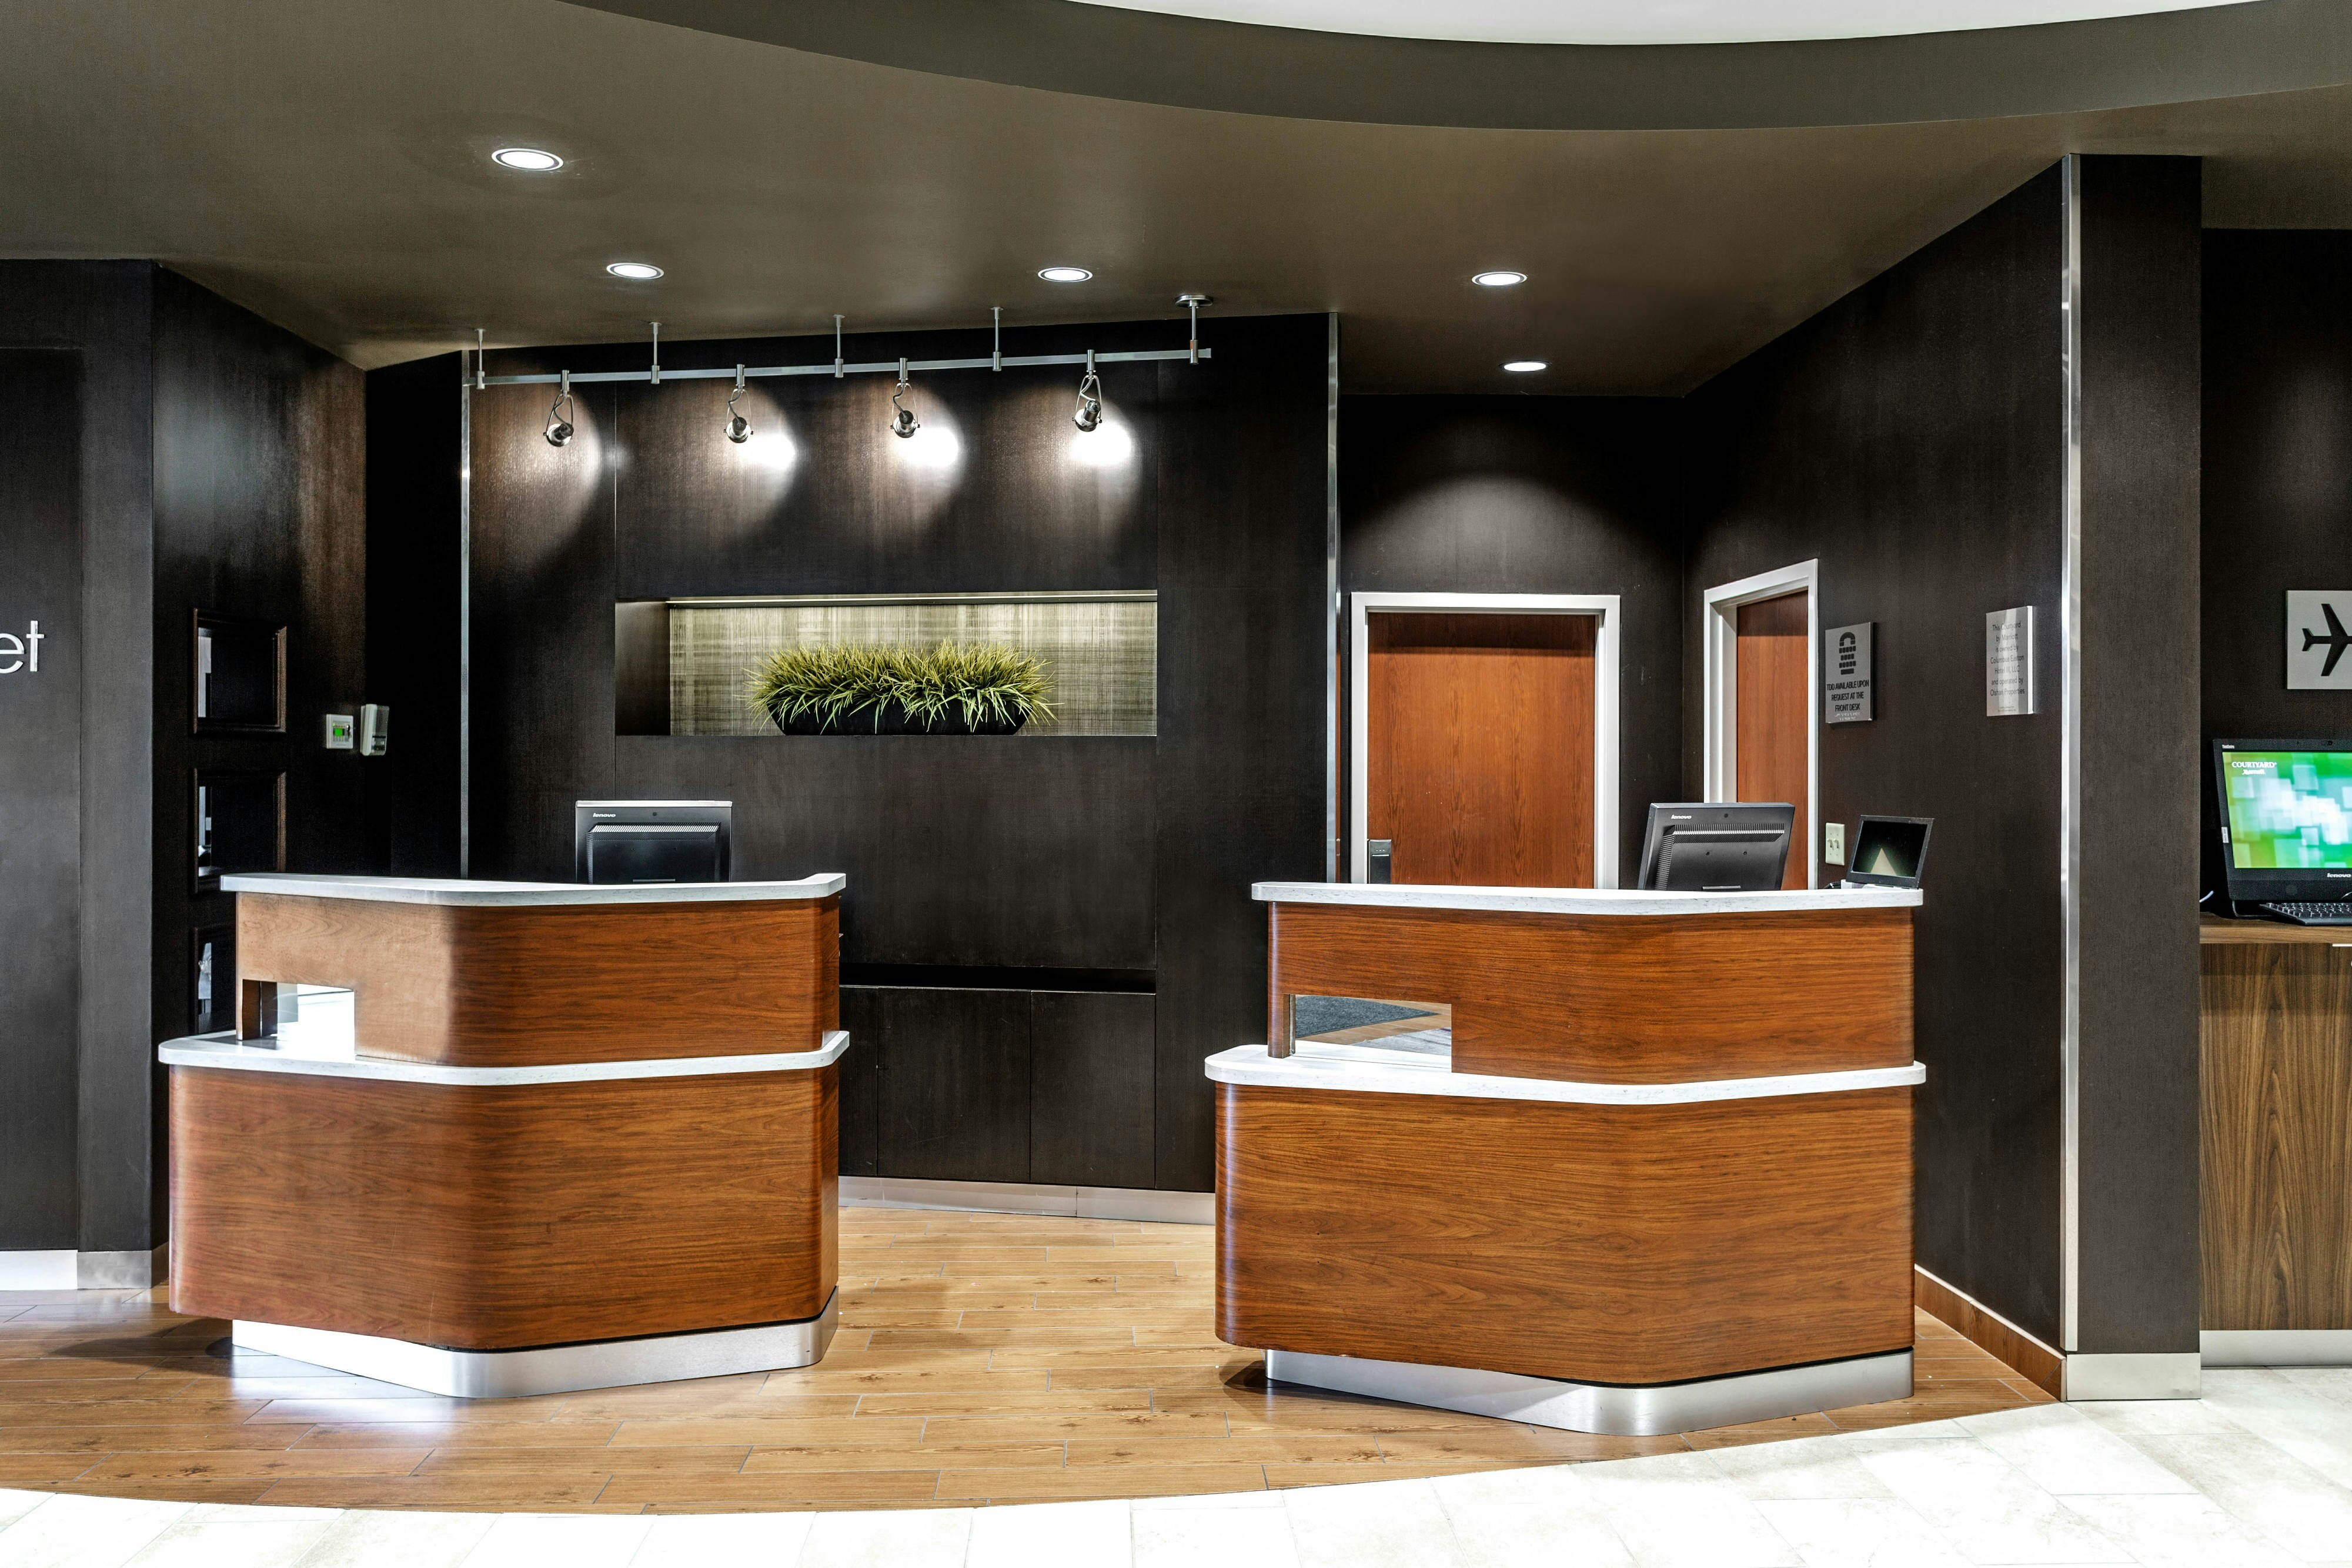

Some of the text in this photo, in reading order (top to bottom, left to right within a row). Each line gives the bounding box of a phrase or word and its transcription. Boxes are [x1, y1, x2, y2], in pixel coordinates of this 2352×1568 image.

[2001, 621, 2021, 631] Courtyard
[1835, 681, 1856, 690] AVAILABLE
[1857, 680, 1869, 688] UPON
[1835, 704, 1849, 712] FRONT
